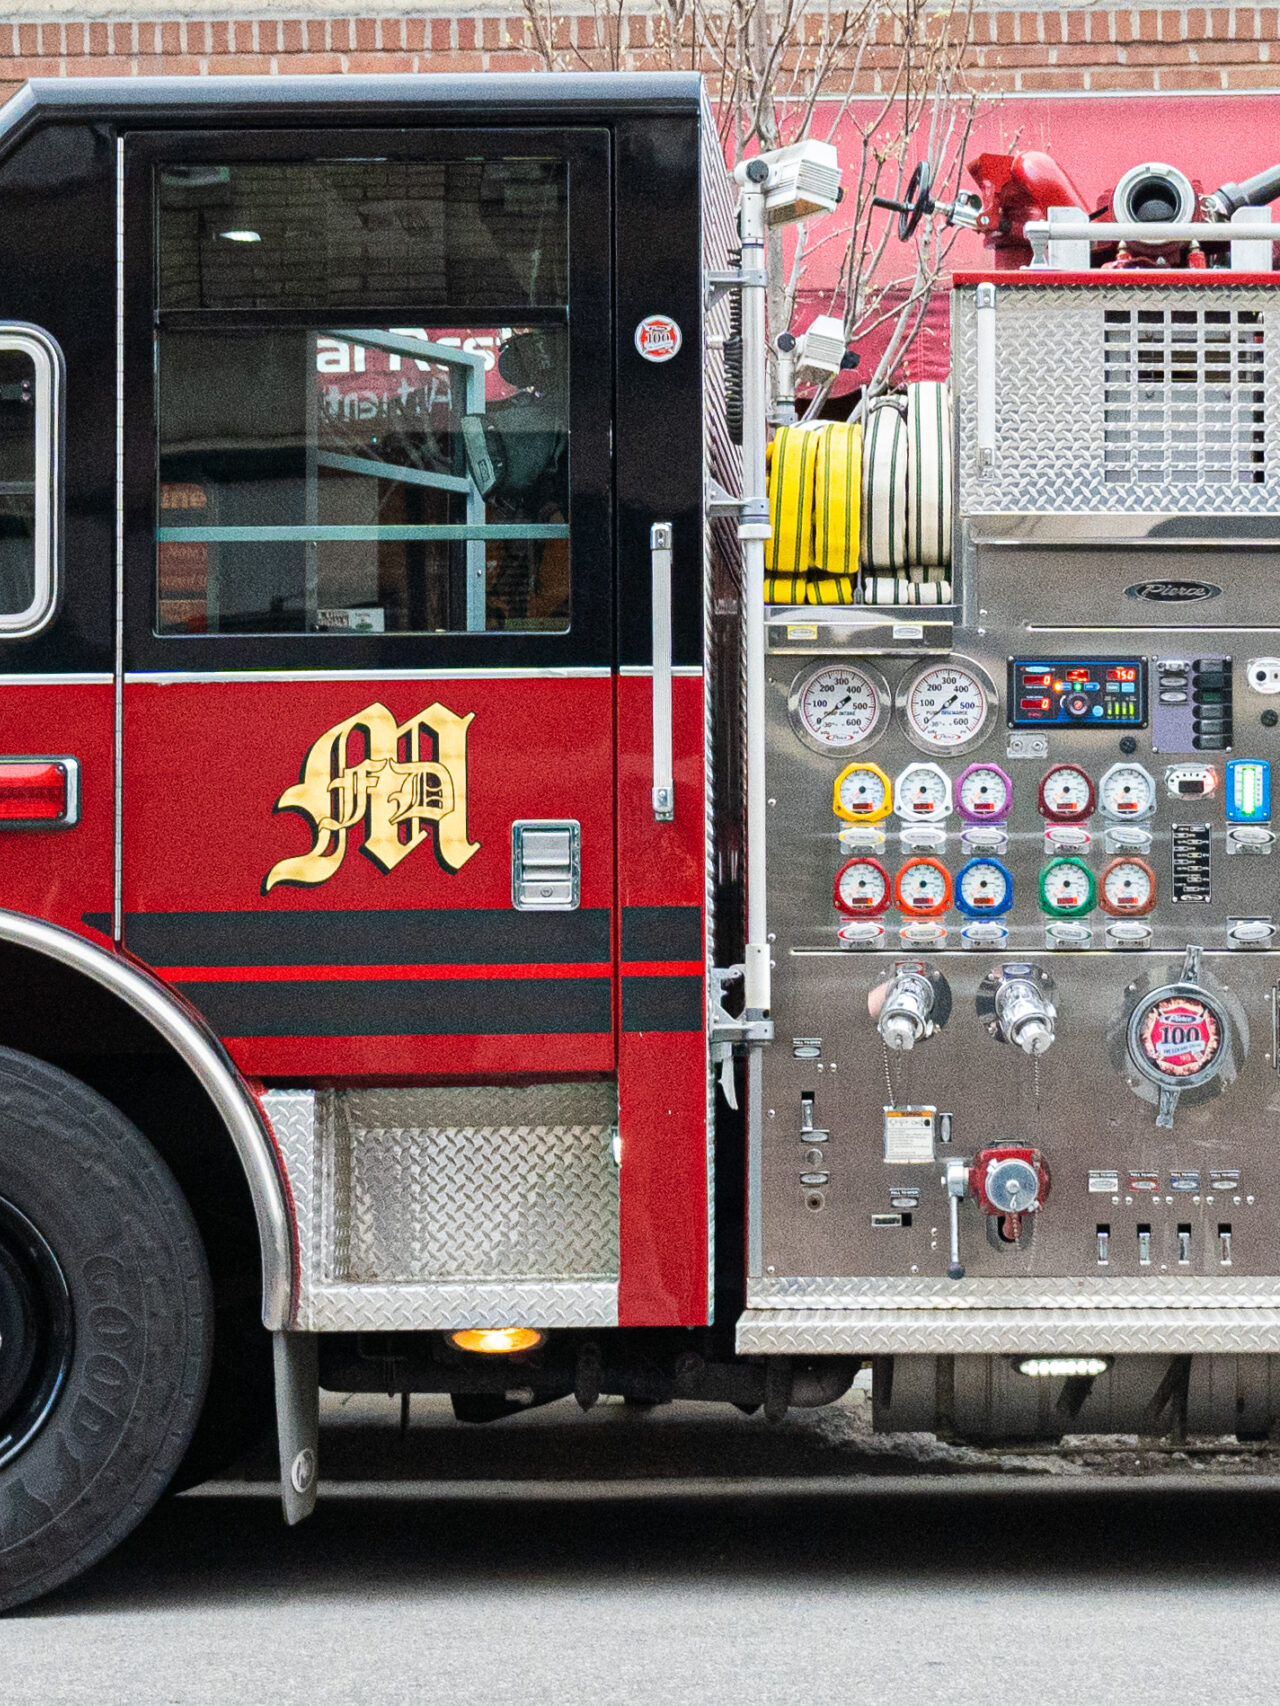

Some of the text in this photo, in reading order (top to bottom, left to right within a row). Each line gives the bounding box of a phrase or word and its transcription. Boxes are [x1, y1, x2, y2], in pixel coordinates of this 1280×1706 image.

[1141, 584, 1206, 598] Pierce
[834, 678, 850, 686] 300
[941, 677, 957, 685] 300
[819, 684, 835, 692] 200
[926, 684, 942, 692] 200
[953, 685, 969, 693] 400
[852, 702, 868, 710] 500
[920, 699, 935, 707] 100
[846, 718, 861, 726] 600
[953, 718, 969, 726] 600
[1160, 1026, 1200, 1045] 100
